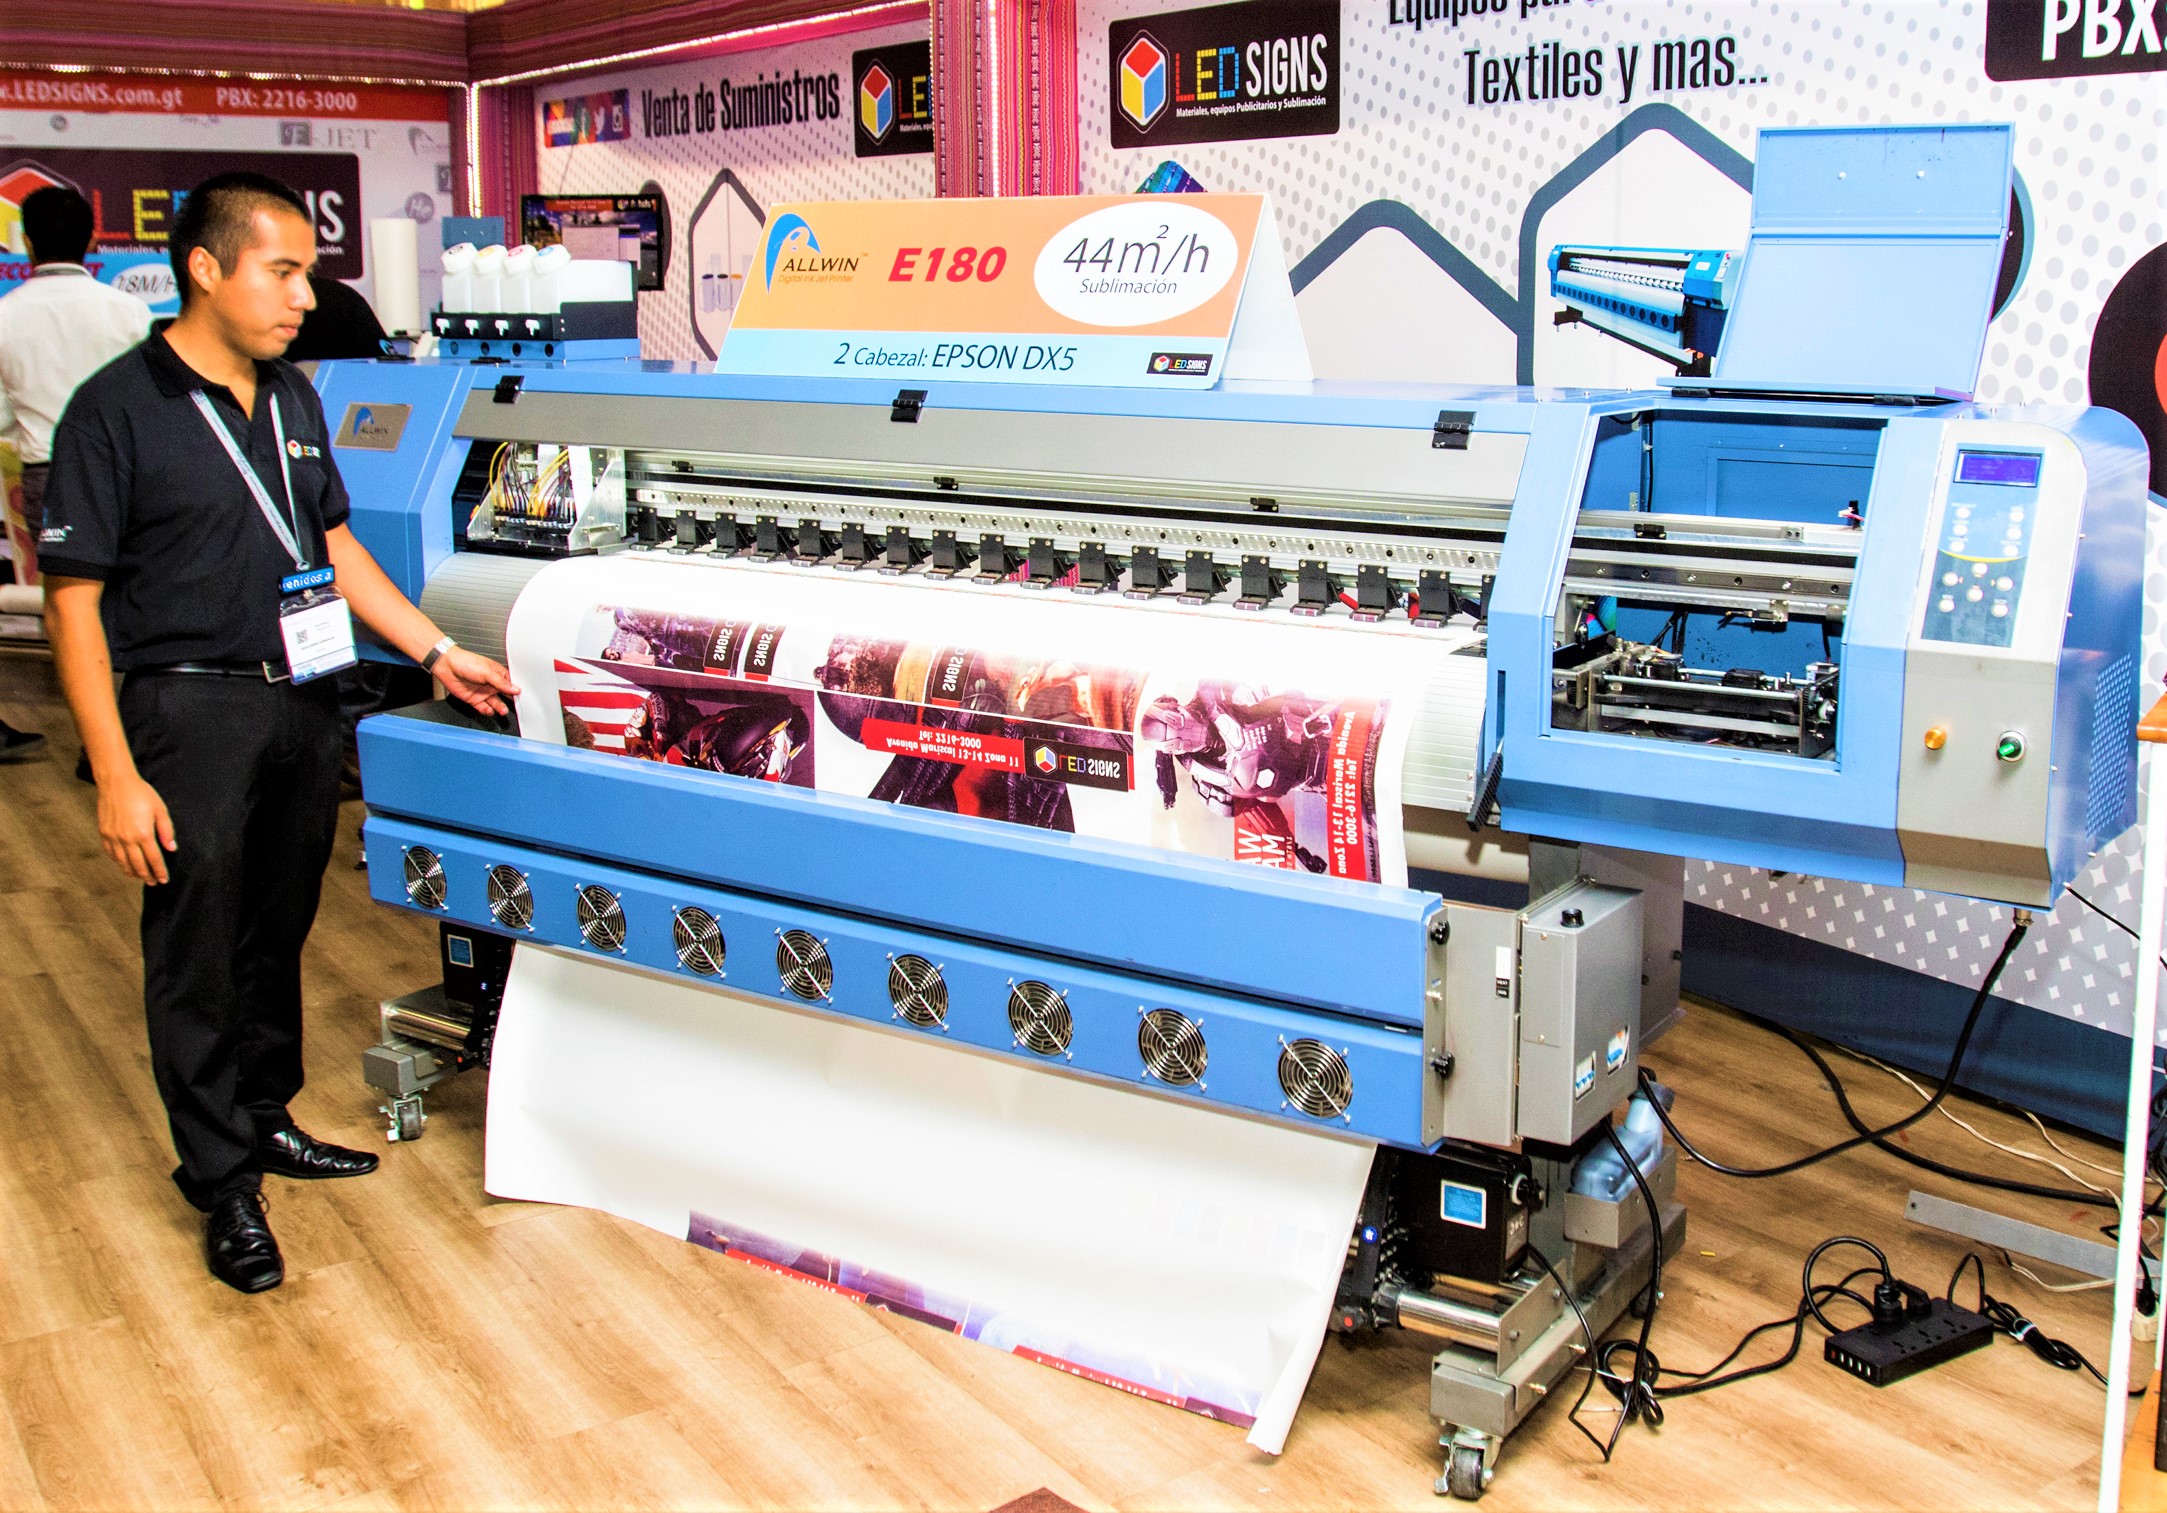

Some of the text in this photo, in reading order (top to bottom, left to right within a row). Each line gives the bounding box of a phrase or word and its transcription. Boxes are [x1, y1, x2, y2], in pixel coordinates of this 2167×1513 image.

[2042, 0, 2167, 61] PBX
[1175, 33, 1328, 102] LED SIGNS
[1463, 35, 1769, 106] Textiles y mas...
[262, 88, 358, 112] 2216-3000
[641, 70, 840, 139] Venta de Suministros
[899, 75, 933, 119] LE
[1176, 105, 1210, 118] Materiales,
[1210, 104, 1236, 116] equipos
[1236, 101, 1277, 113] Publicitarios
[1283, 95, 1327, 108] Sublimación
[778, 274, 854, 284] Digital Ink Jet Printer
[782, 257, 860, 272] ALLWIN
[887, 246, 1008, 283] E180
[1079, 278, 1177, 294] Sublimación
[833, 342, 1077, 371] 2 Cabezal: EPSON DX5
